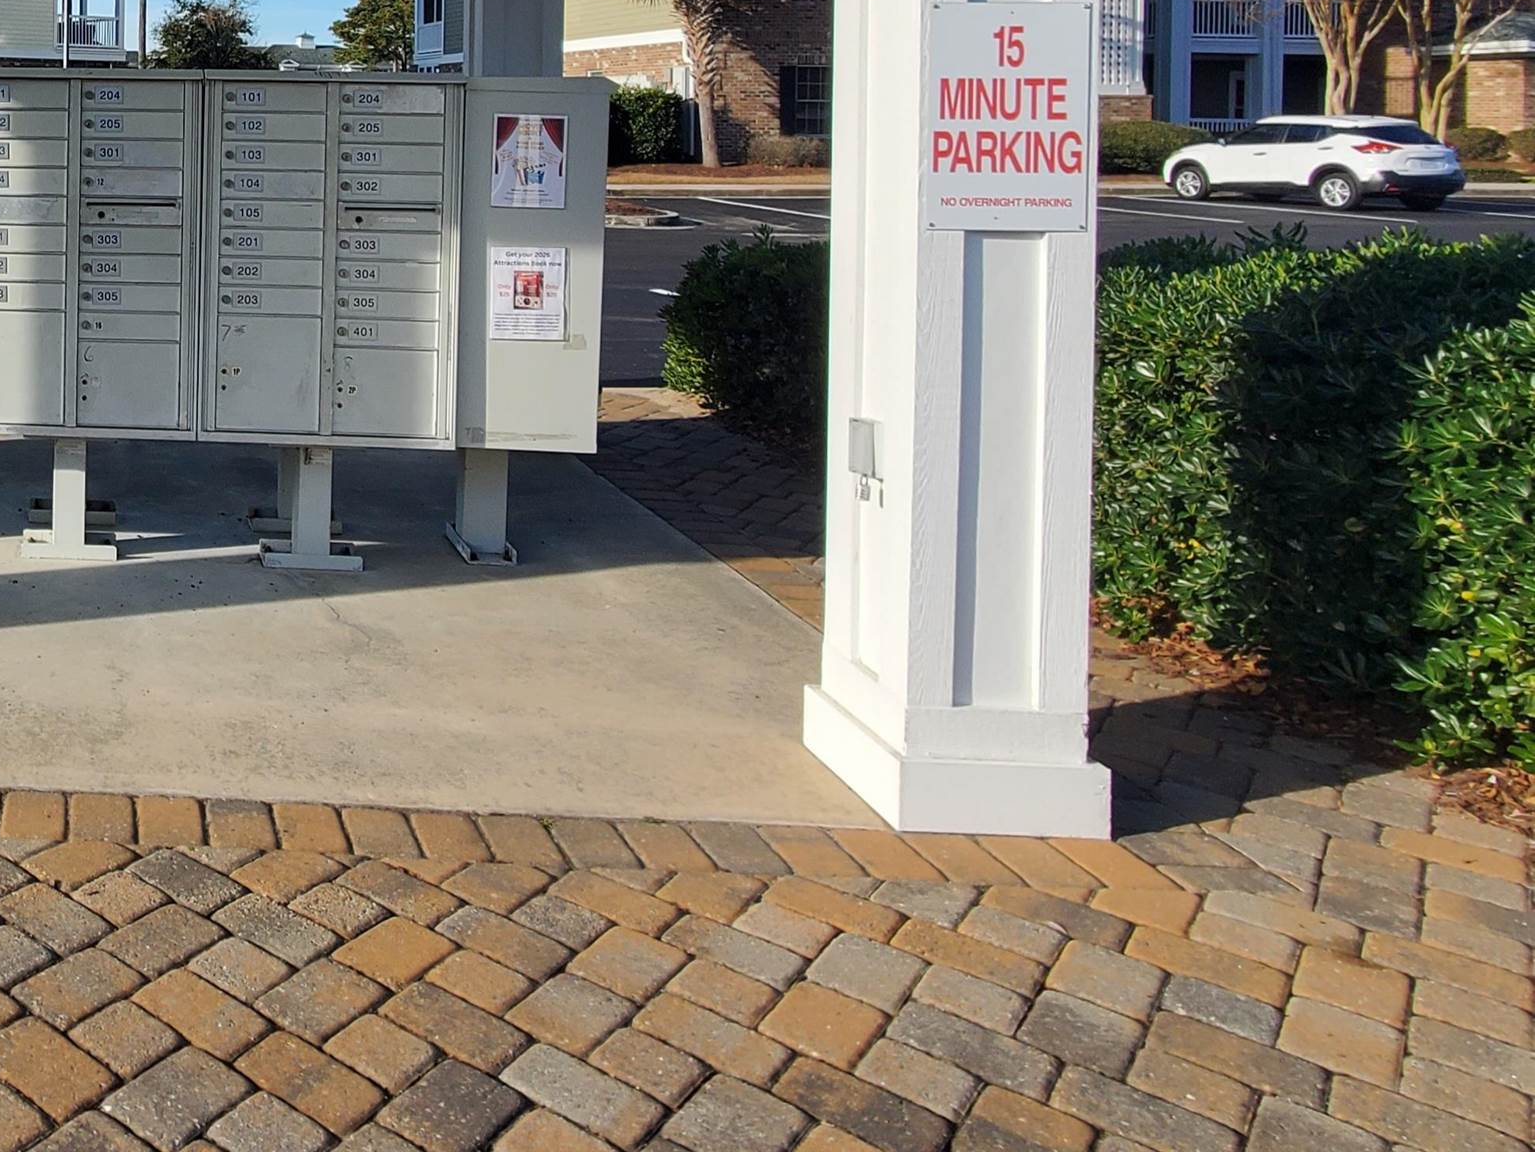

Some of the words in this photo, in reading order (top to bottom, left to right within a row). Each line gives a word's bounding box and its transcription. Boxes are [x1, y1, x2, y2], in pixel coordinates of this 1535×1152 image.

[993, 26, 1025, 68] 15
[100, 91, 120, 100] 204
[242, 93, 261, 101] 101
[359, 95, 379, 103] 204
[939, 78, 1068, 121] MINUTE
[100, 119, 120, 129] 205
[242, 122, 262, 130] 102
[359, 124, 380, 132] 205
[100, 148, 119, 157] 301
[242, 151, 261, 159] 103
[932, 131, 1083, 174] PARKING
[357, 153, 377, 161] 301
[240, 179, 260, 187] 104
[356, 182, 378, 190] 302
[941, 198, 957, 207] NO
[959, 198, 1022, 208] OVERNIGHT
[1024, 198, 1073, 208] PARKING
[240, 208, 260, 217] 105
[98, 235, 118, 244] 303
[238, 238, 258, 246] 201
[355, 241, 376, 249] 303
[97, 264, 117, 272] 304
[237, 267, 258, 276] 202
[354, 270, 375, 278] 304
[98, 292, 118, 301] 305
[237, 296, 258, 304] 203
[353, 298, 375, 307] 305
[353, 328, 373, 336] 401
